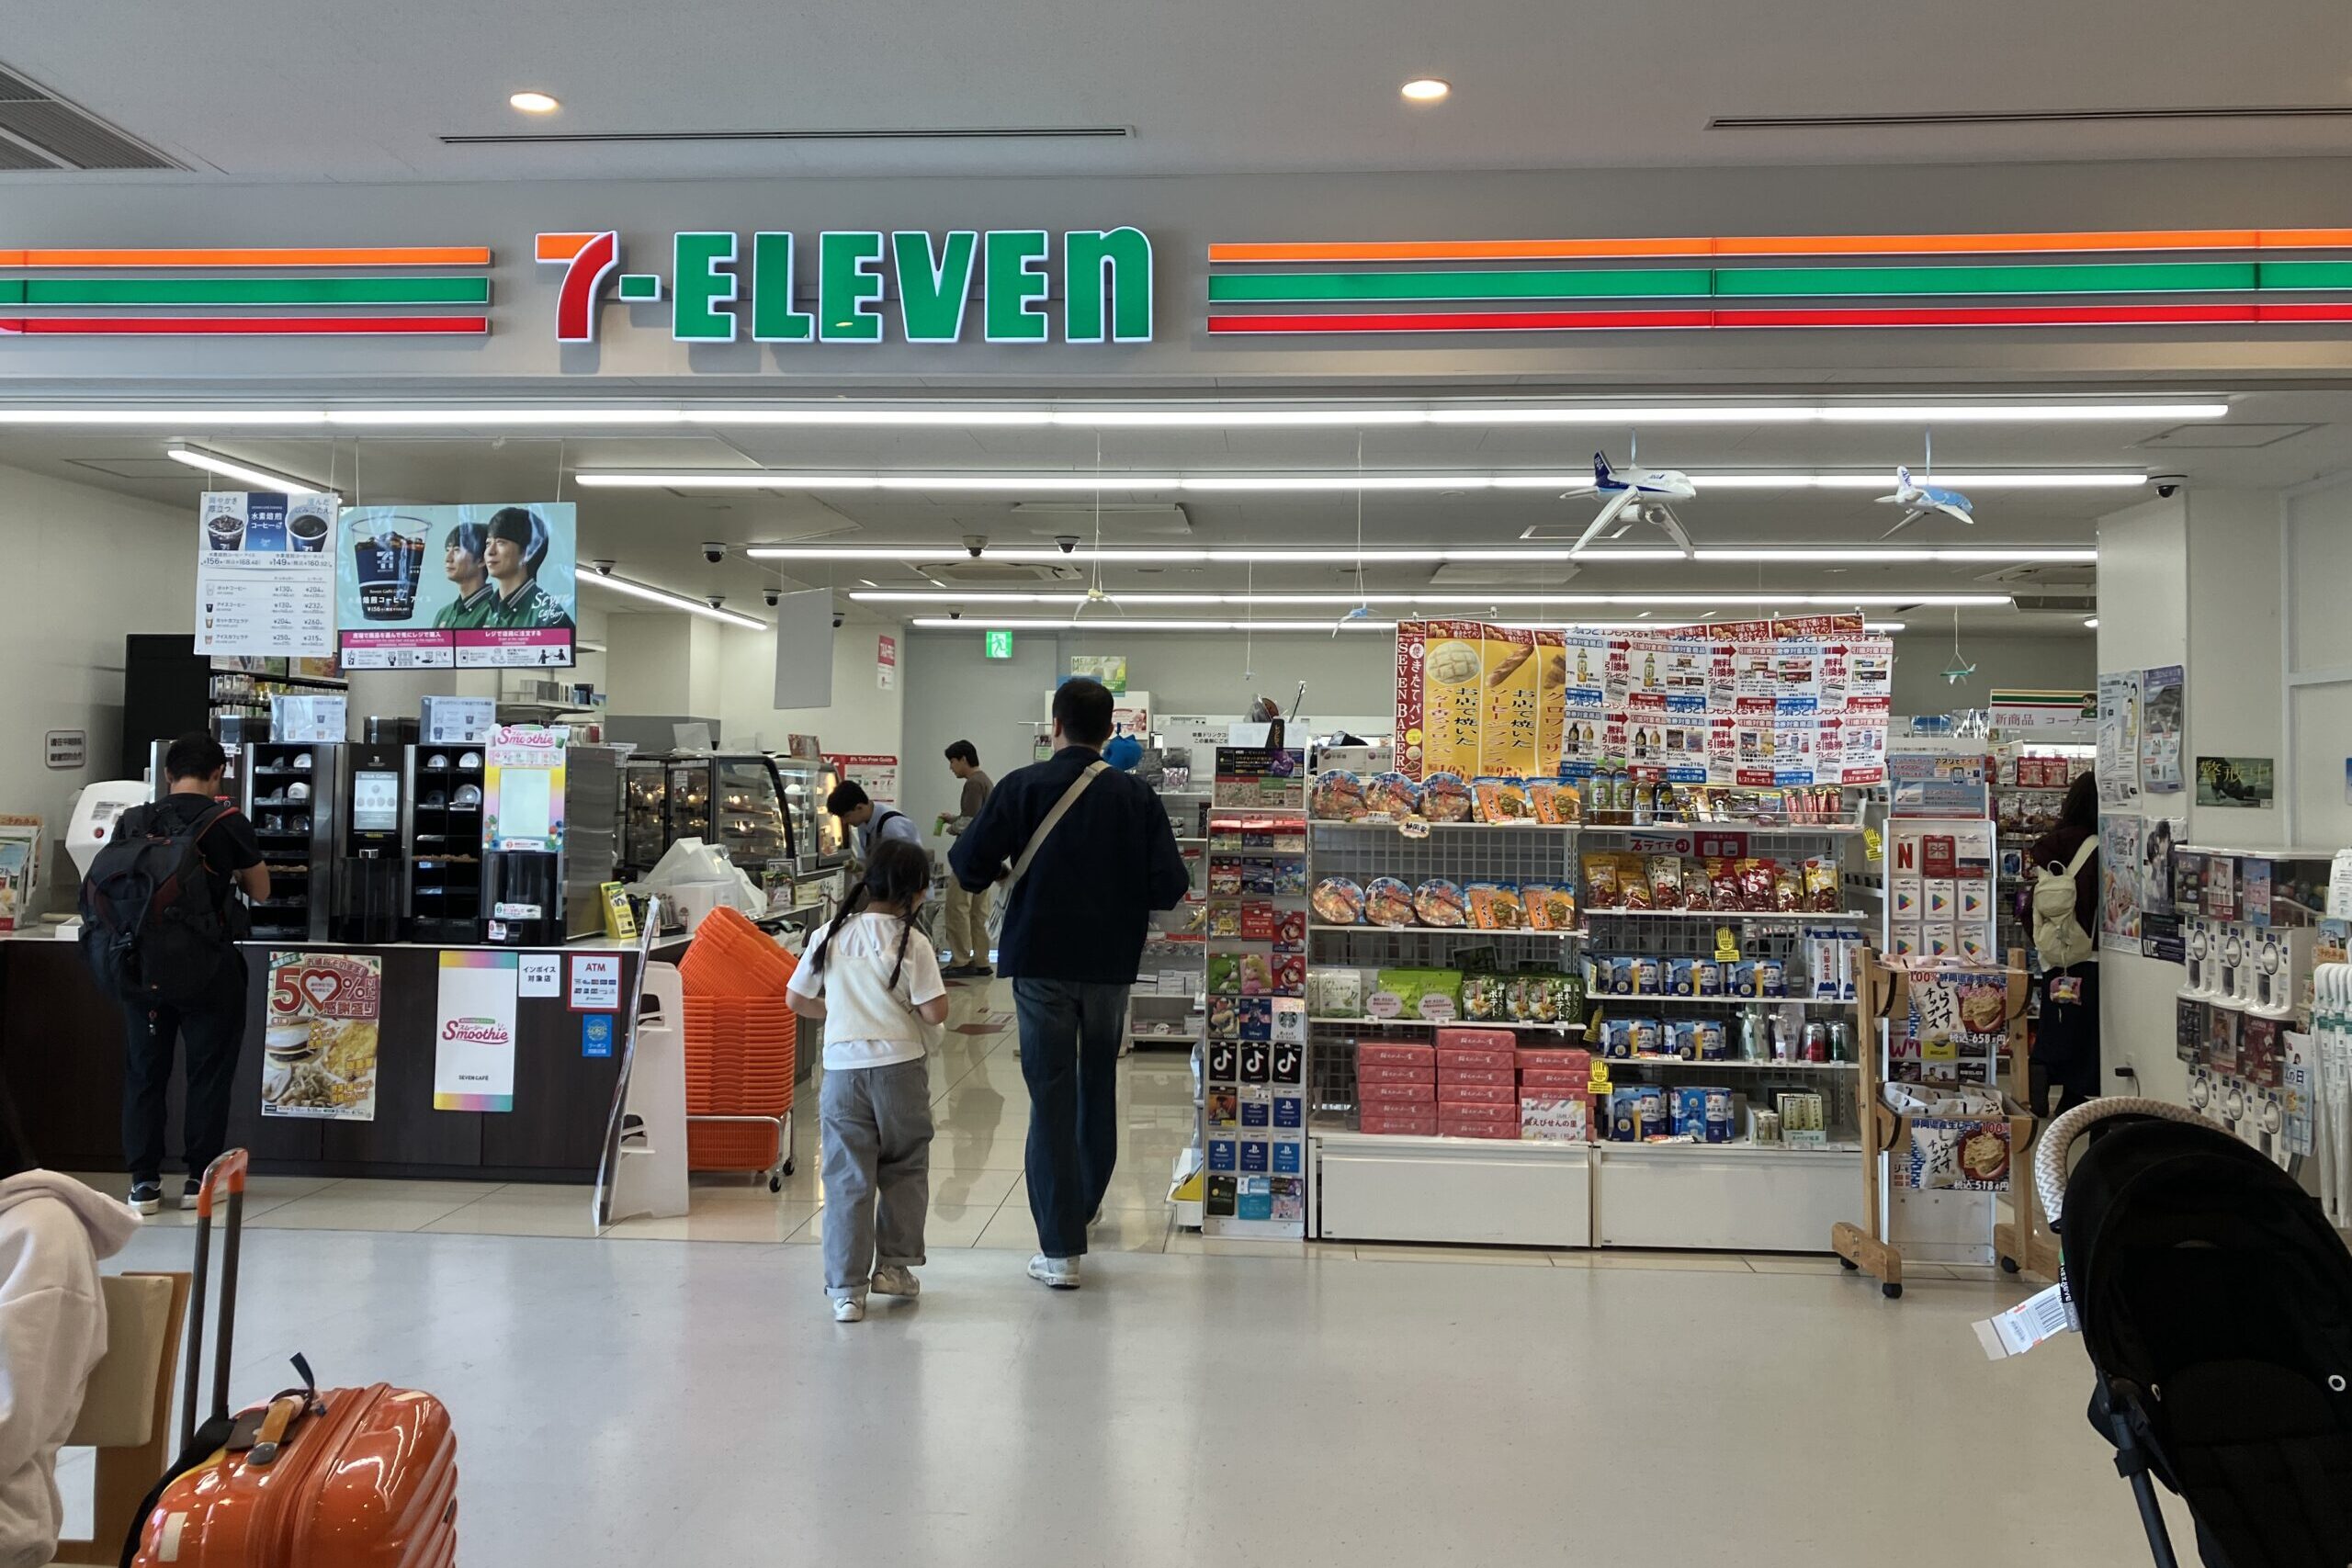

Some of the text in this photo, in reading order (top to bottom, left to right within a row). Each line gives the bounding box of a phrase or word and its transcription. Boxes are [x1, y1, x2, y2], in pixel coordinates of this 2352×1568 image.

[1996, 714, 2097, 727] 新商品 コーナー
[523, 965, 556, 974] インボイス
[585, 963, 605, 972] ATM
[528, 975, 551, 983] 対象店
[442, 1020, 509, 1043] Smoothie
